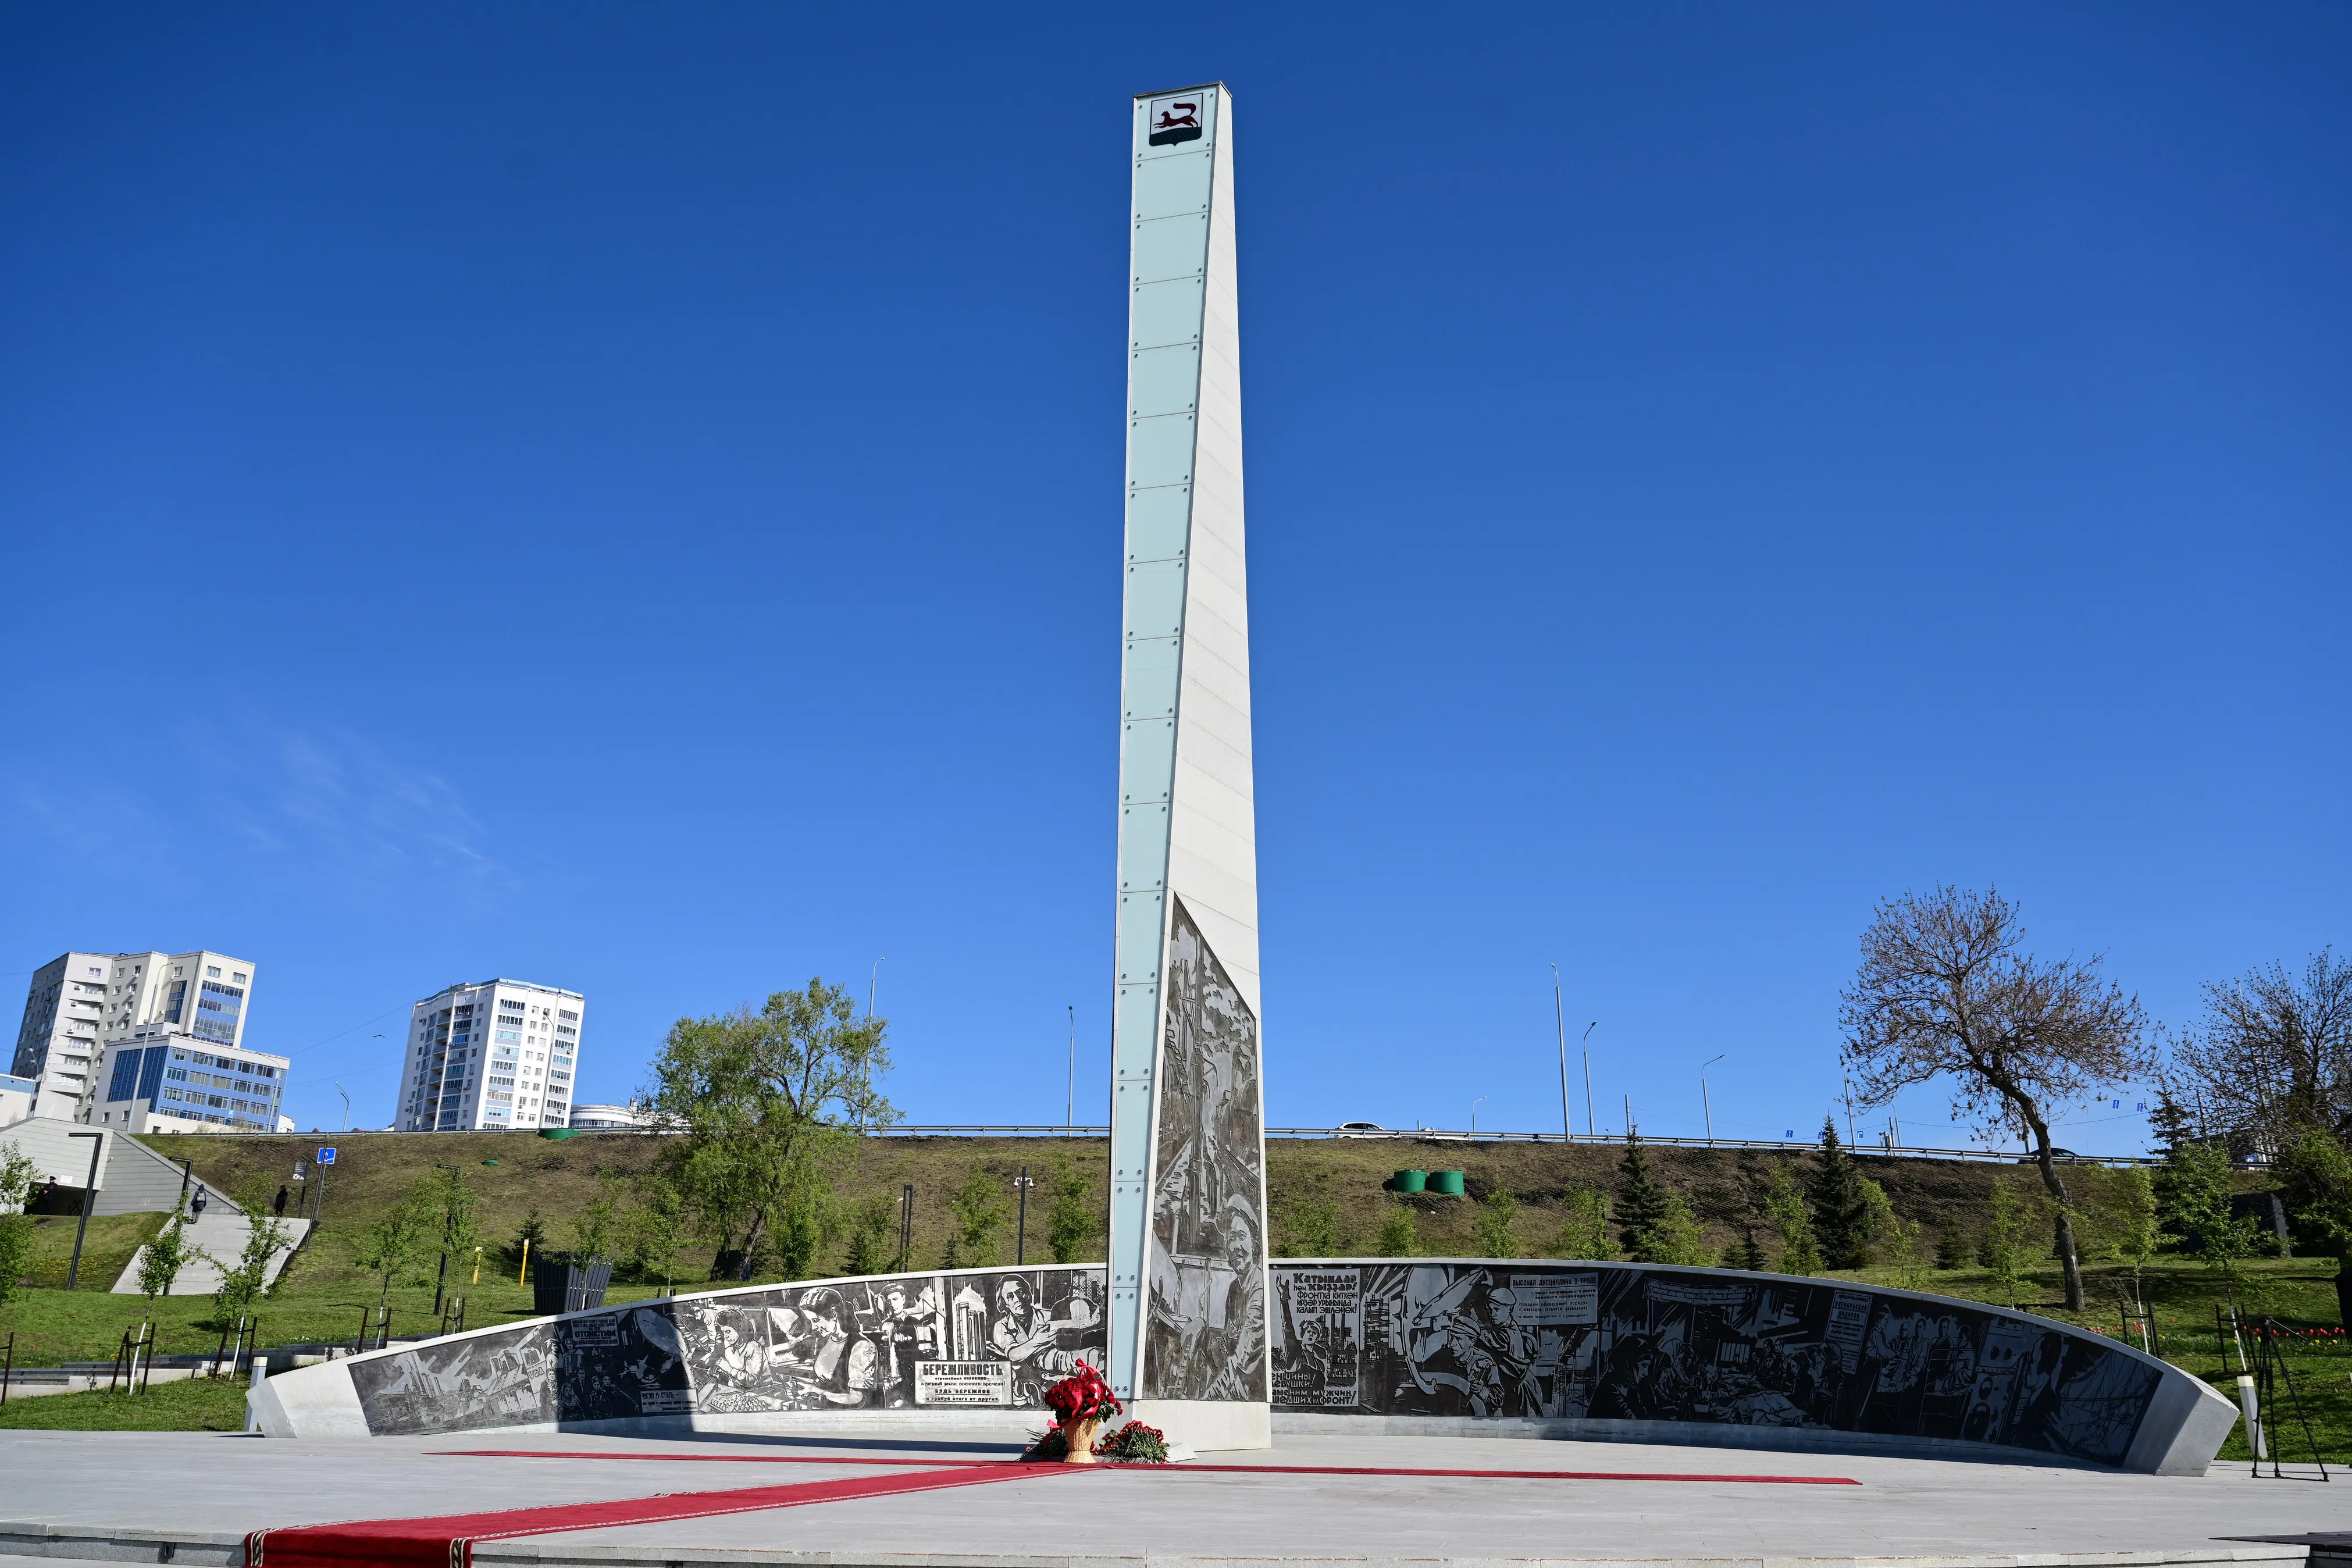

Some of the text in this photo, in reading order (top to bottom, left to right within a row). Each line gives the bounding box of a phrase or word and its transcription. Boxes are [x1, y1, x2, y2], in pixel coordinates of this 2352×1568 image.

[1539, 1278, 1571, 1287] ДИСЦИПЛИНА
[528, 1367, 545, 1380] УФА
[923, 1364, 1004, 1375] БЕРЕЖЛИВОСТЬ,
